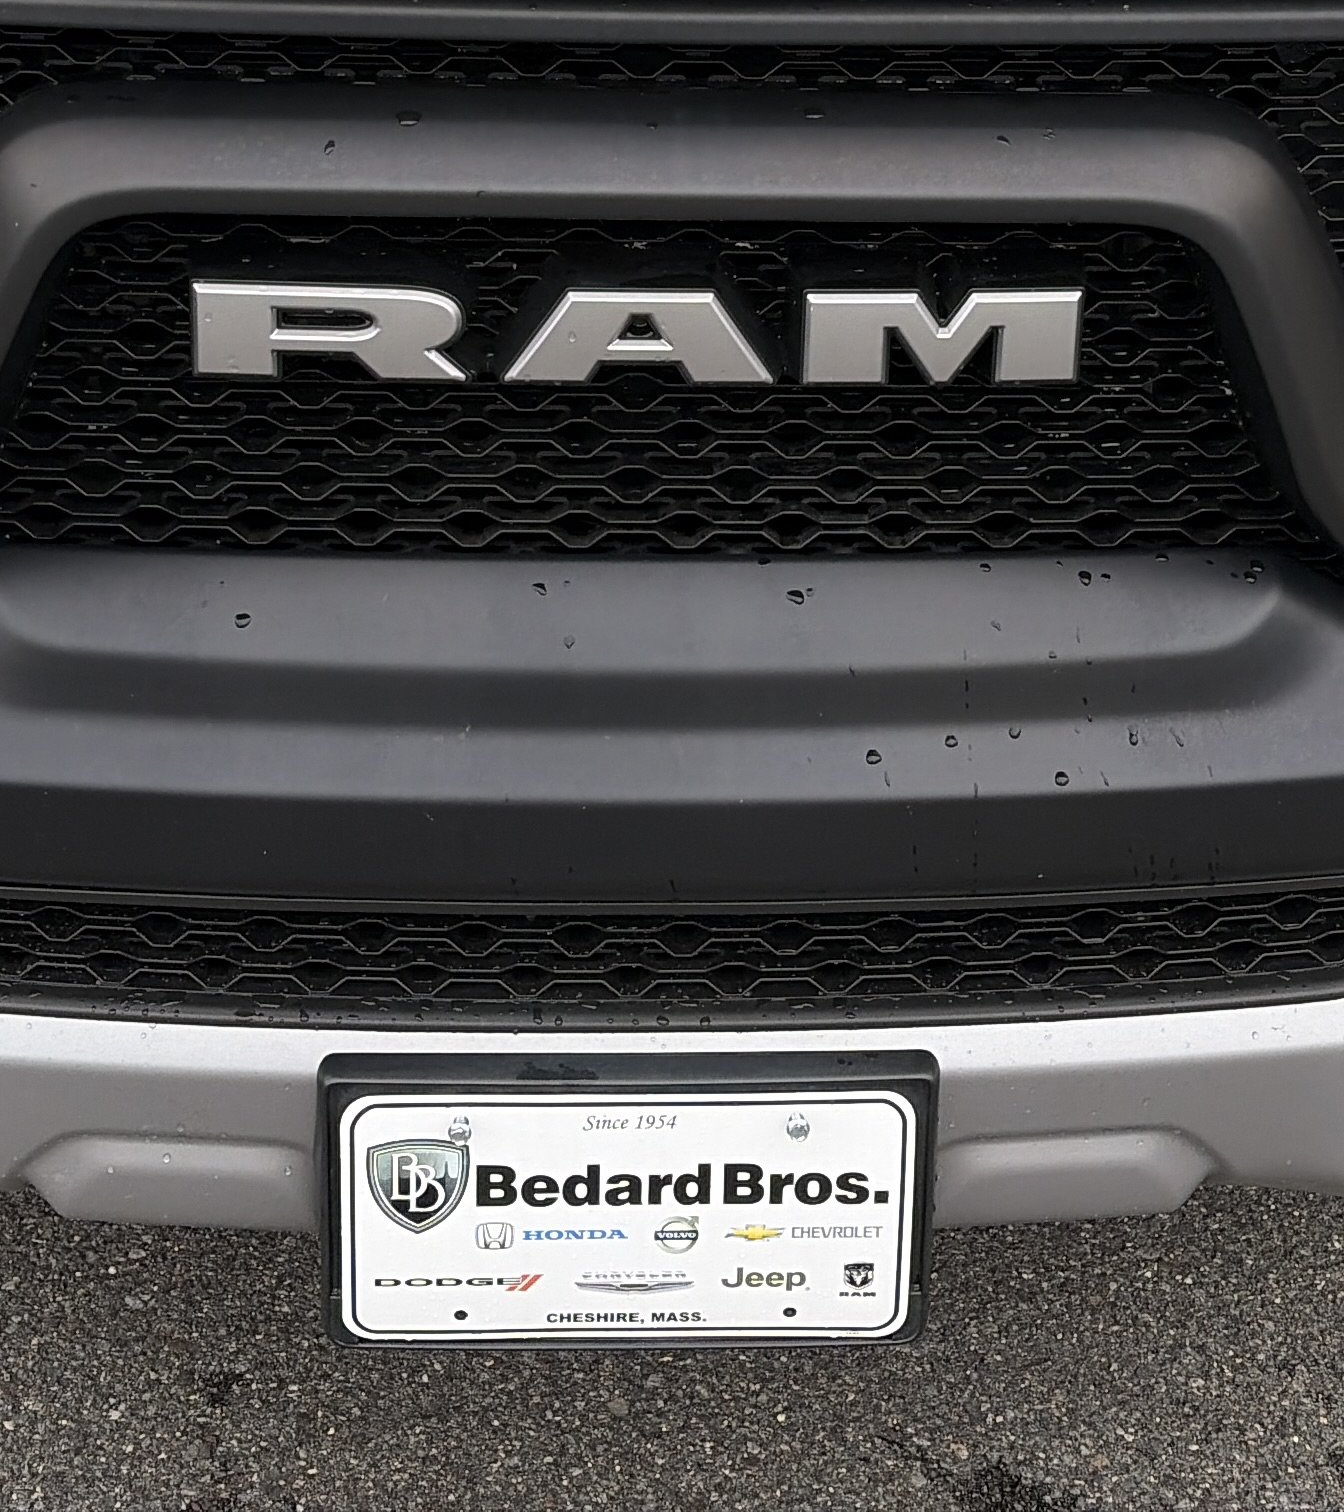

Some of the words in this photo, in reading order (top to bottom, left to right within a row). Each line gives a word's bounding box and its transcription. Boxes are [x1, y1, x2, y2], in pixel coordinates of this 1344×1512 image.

[191, 279, 1085, 385] RAM
[582, 1115, 629, 1131] Since
[634, 1114, 678, 1130] 1954
[475, 1163, 712, 1208] Bedard
[722, 1162, 890, 1206] Bros.
[523, 1229, 628, 1240] HONDA
[657, 1231, 697, 1239] VOLVO
[792, 1226, 883, 1238] CHEVROLET
[374, 1278, 522, 1286] DODGE
[721, 1266, 807, 1292] Jeep
[546, 1312, 645, 1324] CHESHIRE,
[651, 1312, 707, 1323] MASS.
